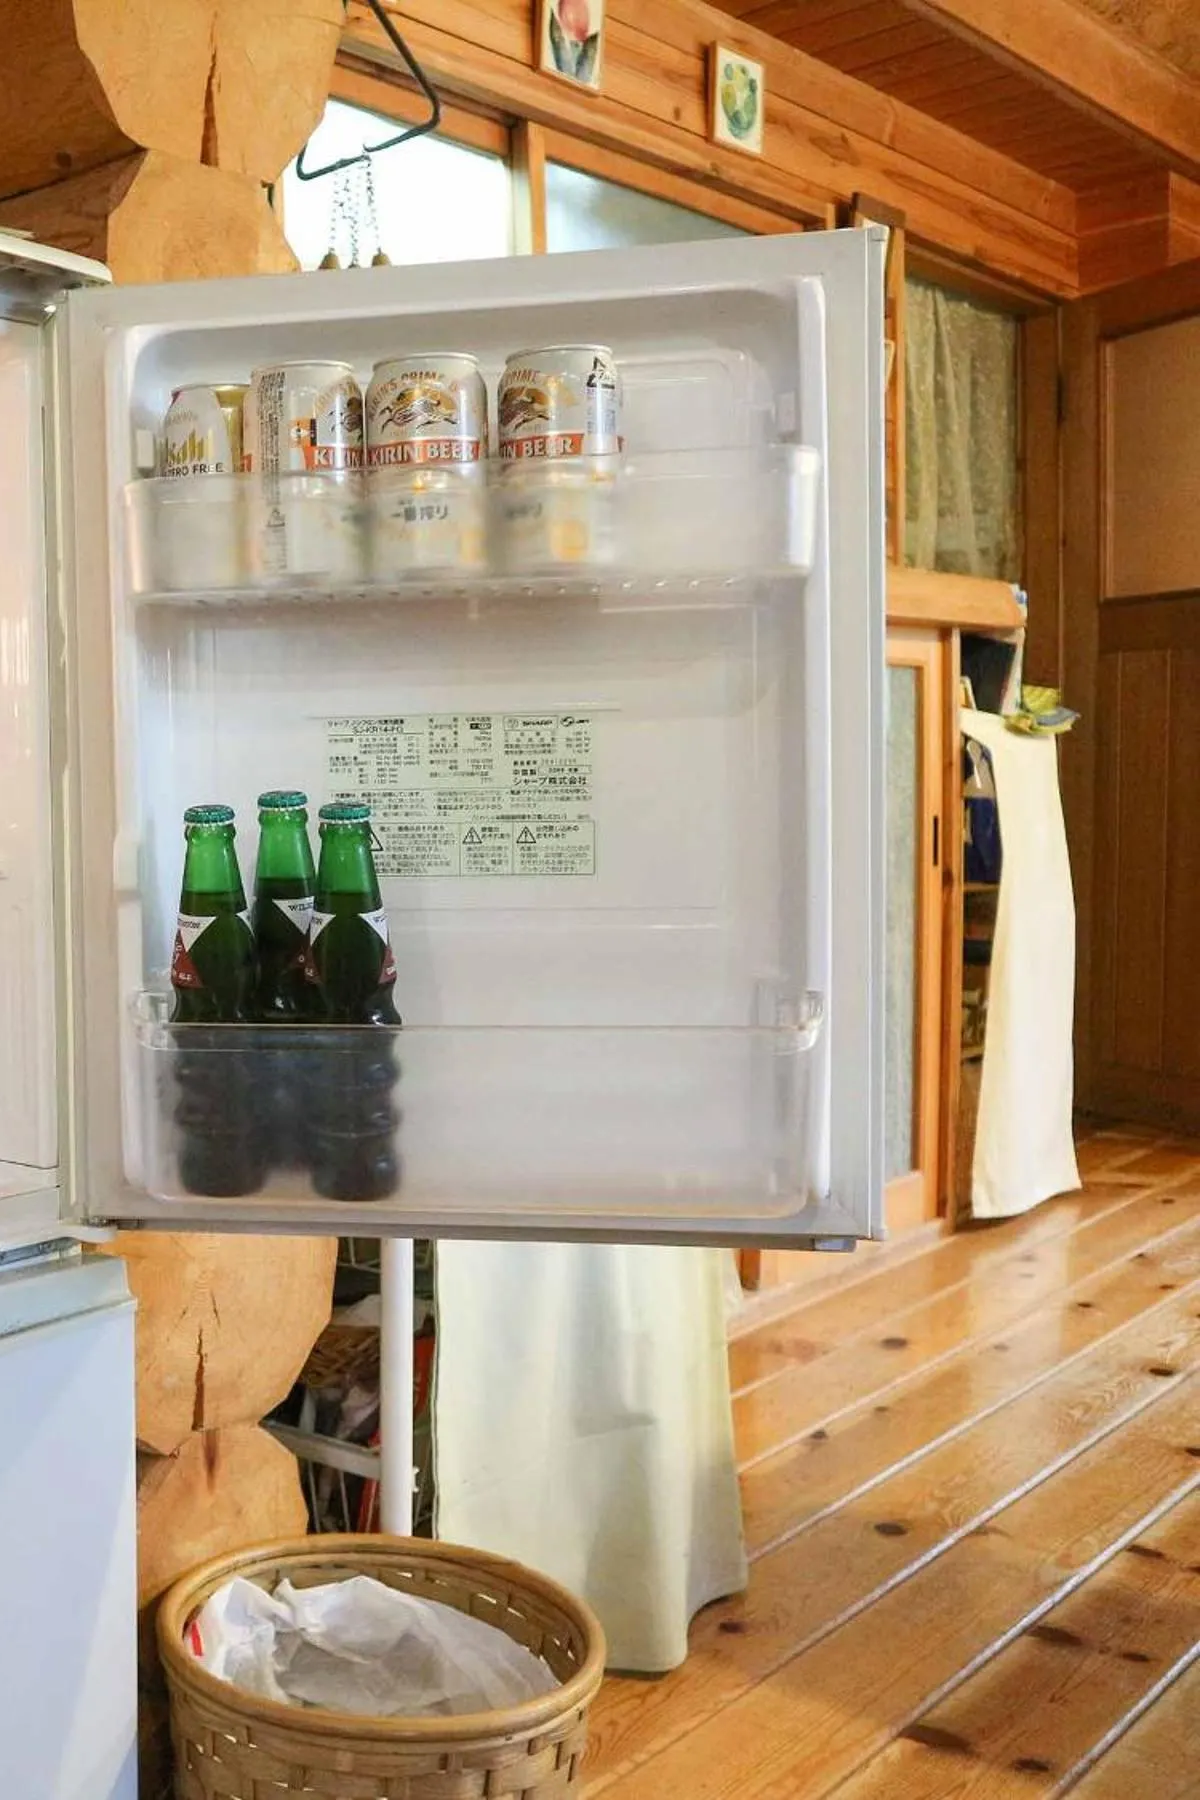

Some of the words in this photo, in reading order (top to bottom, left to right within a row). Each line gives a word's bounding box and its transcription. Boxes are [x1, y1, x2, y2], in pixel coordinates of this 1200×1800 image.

[314, 446, 362, 471] KIIN
[370, 442, 424, 465] KIRIN
[428, 440, 475, 461] BEER
[521, 438, 574, 458] BEER
